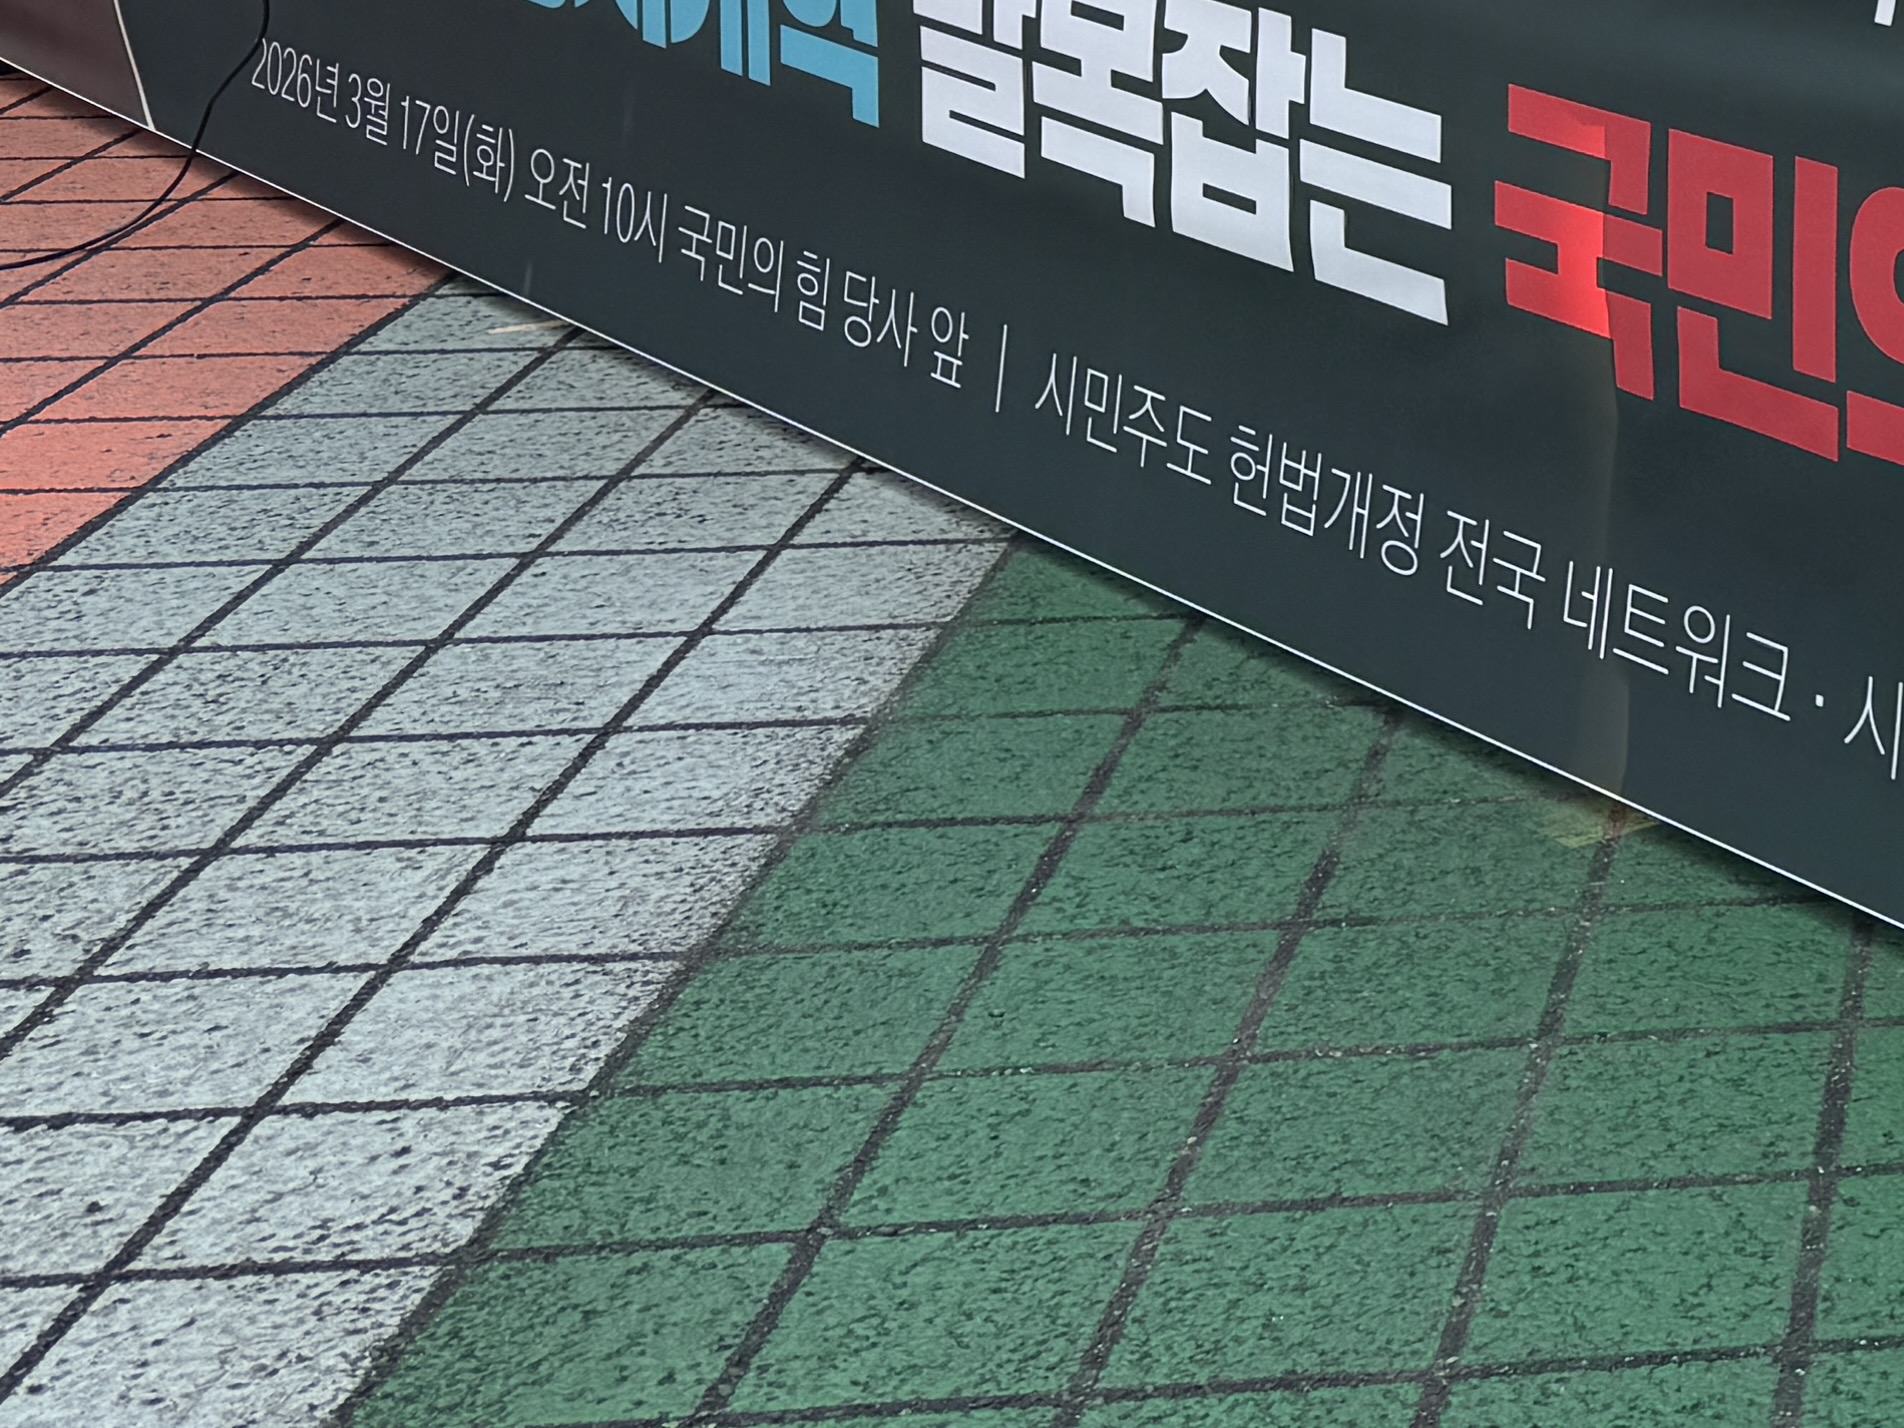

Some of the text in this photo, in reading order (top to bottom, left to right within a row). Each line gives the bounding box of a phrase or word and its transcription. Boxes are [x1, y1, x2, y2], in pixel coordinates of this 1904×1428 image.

[251, 36, 343, 123] 2026년
[345, 68, 391, 147] 3월
[400, 95, 516, 204] 17일(화)
[524, 147, 592, 230] 오전
[601, 176, 669, 263] 10시
[841, 269, 919, 368] 당사
[929, 305, 970, 390] 앞
[1034, 351, 1213, 486] 시민주도
[1228, 423, 1426, 577] 헌법개정
[1439, 508, 1546, 630] 전국
[1562, 560, 1793, 722] 네트워크
